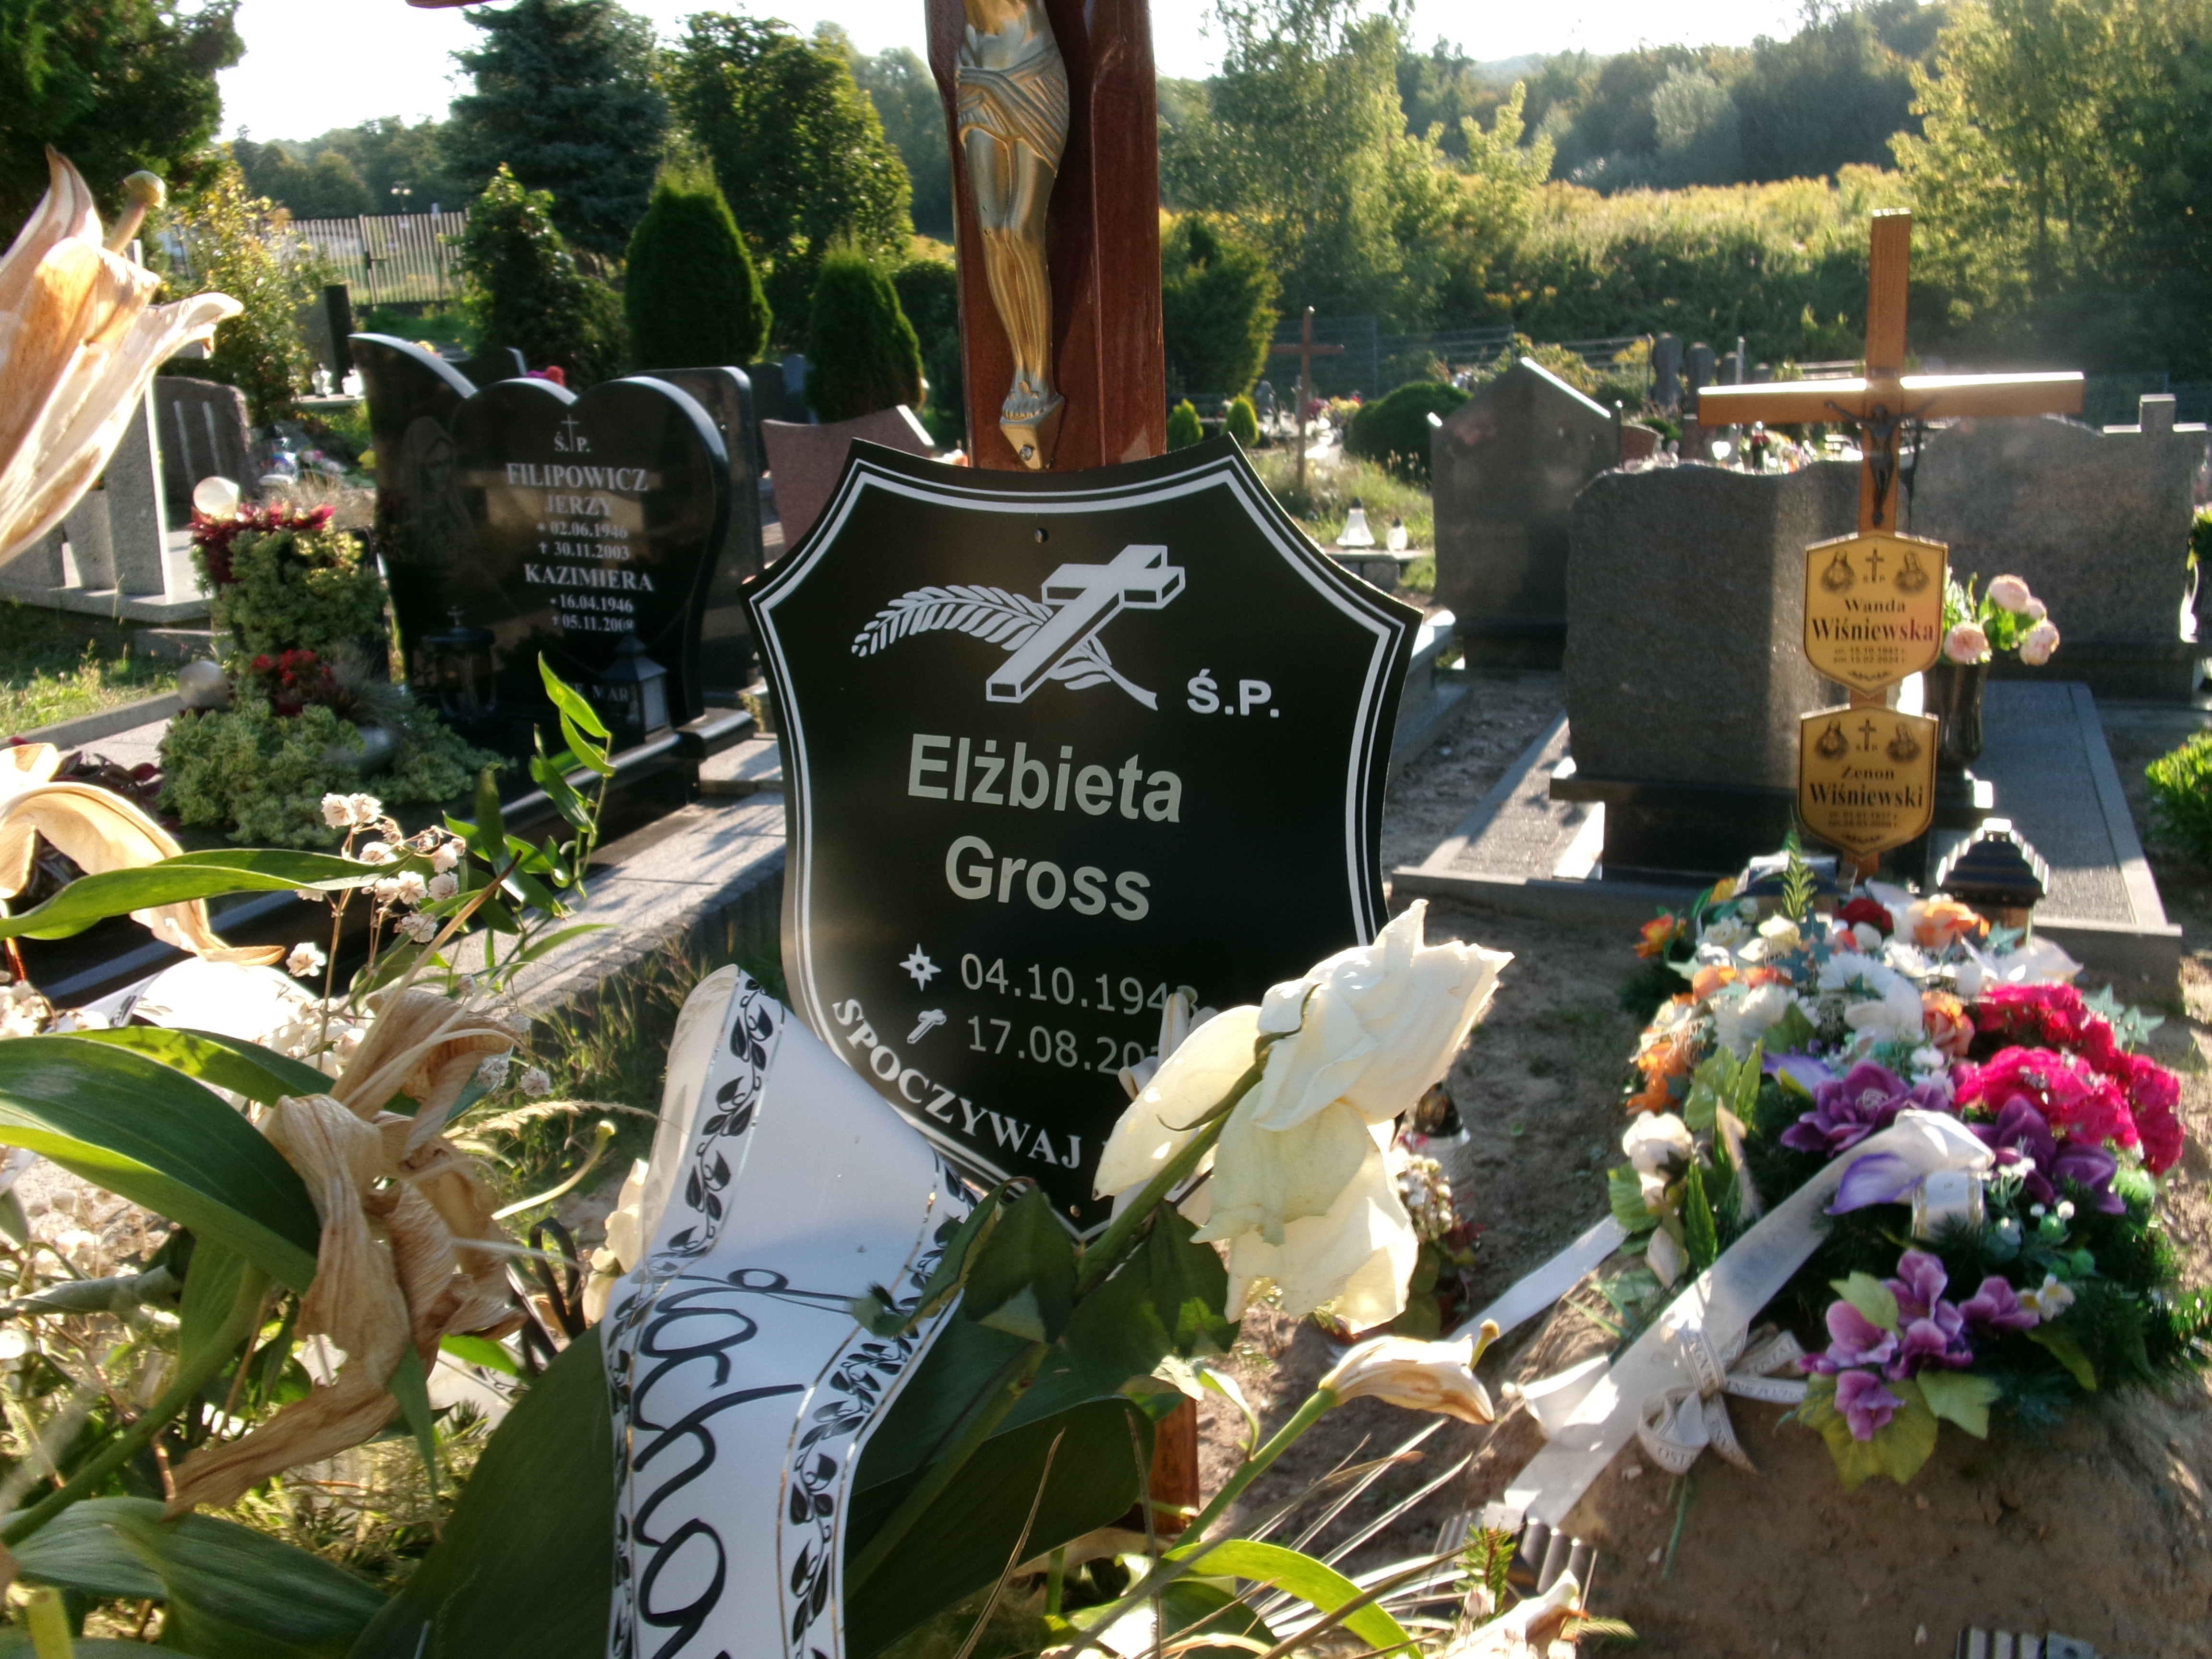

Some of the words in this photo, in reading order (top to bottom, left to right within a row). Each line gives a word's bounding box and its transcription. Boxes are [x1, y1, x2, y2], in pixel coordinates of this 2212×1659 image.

[506, 463, 649, 492] FILIPOWICZ
[546, 496, 613, 517] JERZY
[524, 564, 654, 592] KAZIMIERA
[560, 594, 634, 613] 16.04.1946
[1845, 599, 1906, 613] Wanda
[1812, 617, 1934, 641] Wiśniewska
[1188, 669, 1279, 717] Ś.P.
[908, 734, 1182, 822] Elżbieta
[1841, 765, 1895, 781] Zenon
[1810, 783, 1923, 808] Wiśniewski
[946, 836, 1150, 921] Gross
[832, 998, 1081, 1169] SPOCZYWAJ
[632, 1267, 854, 1659] Kocha
